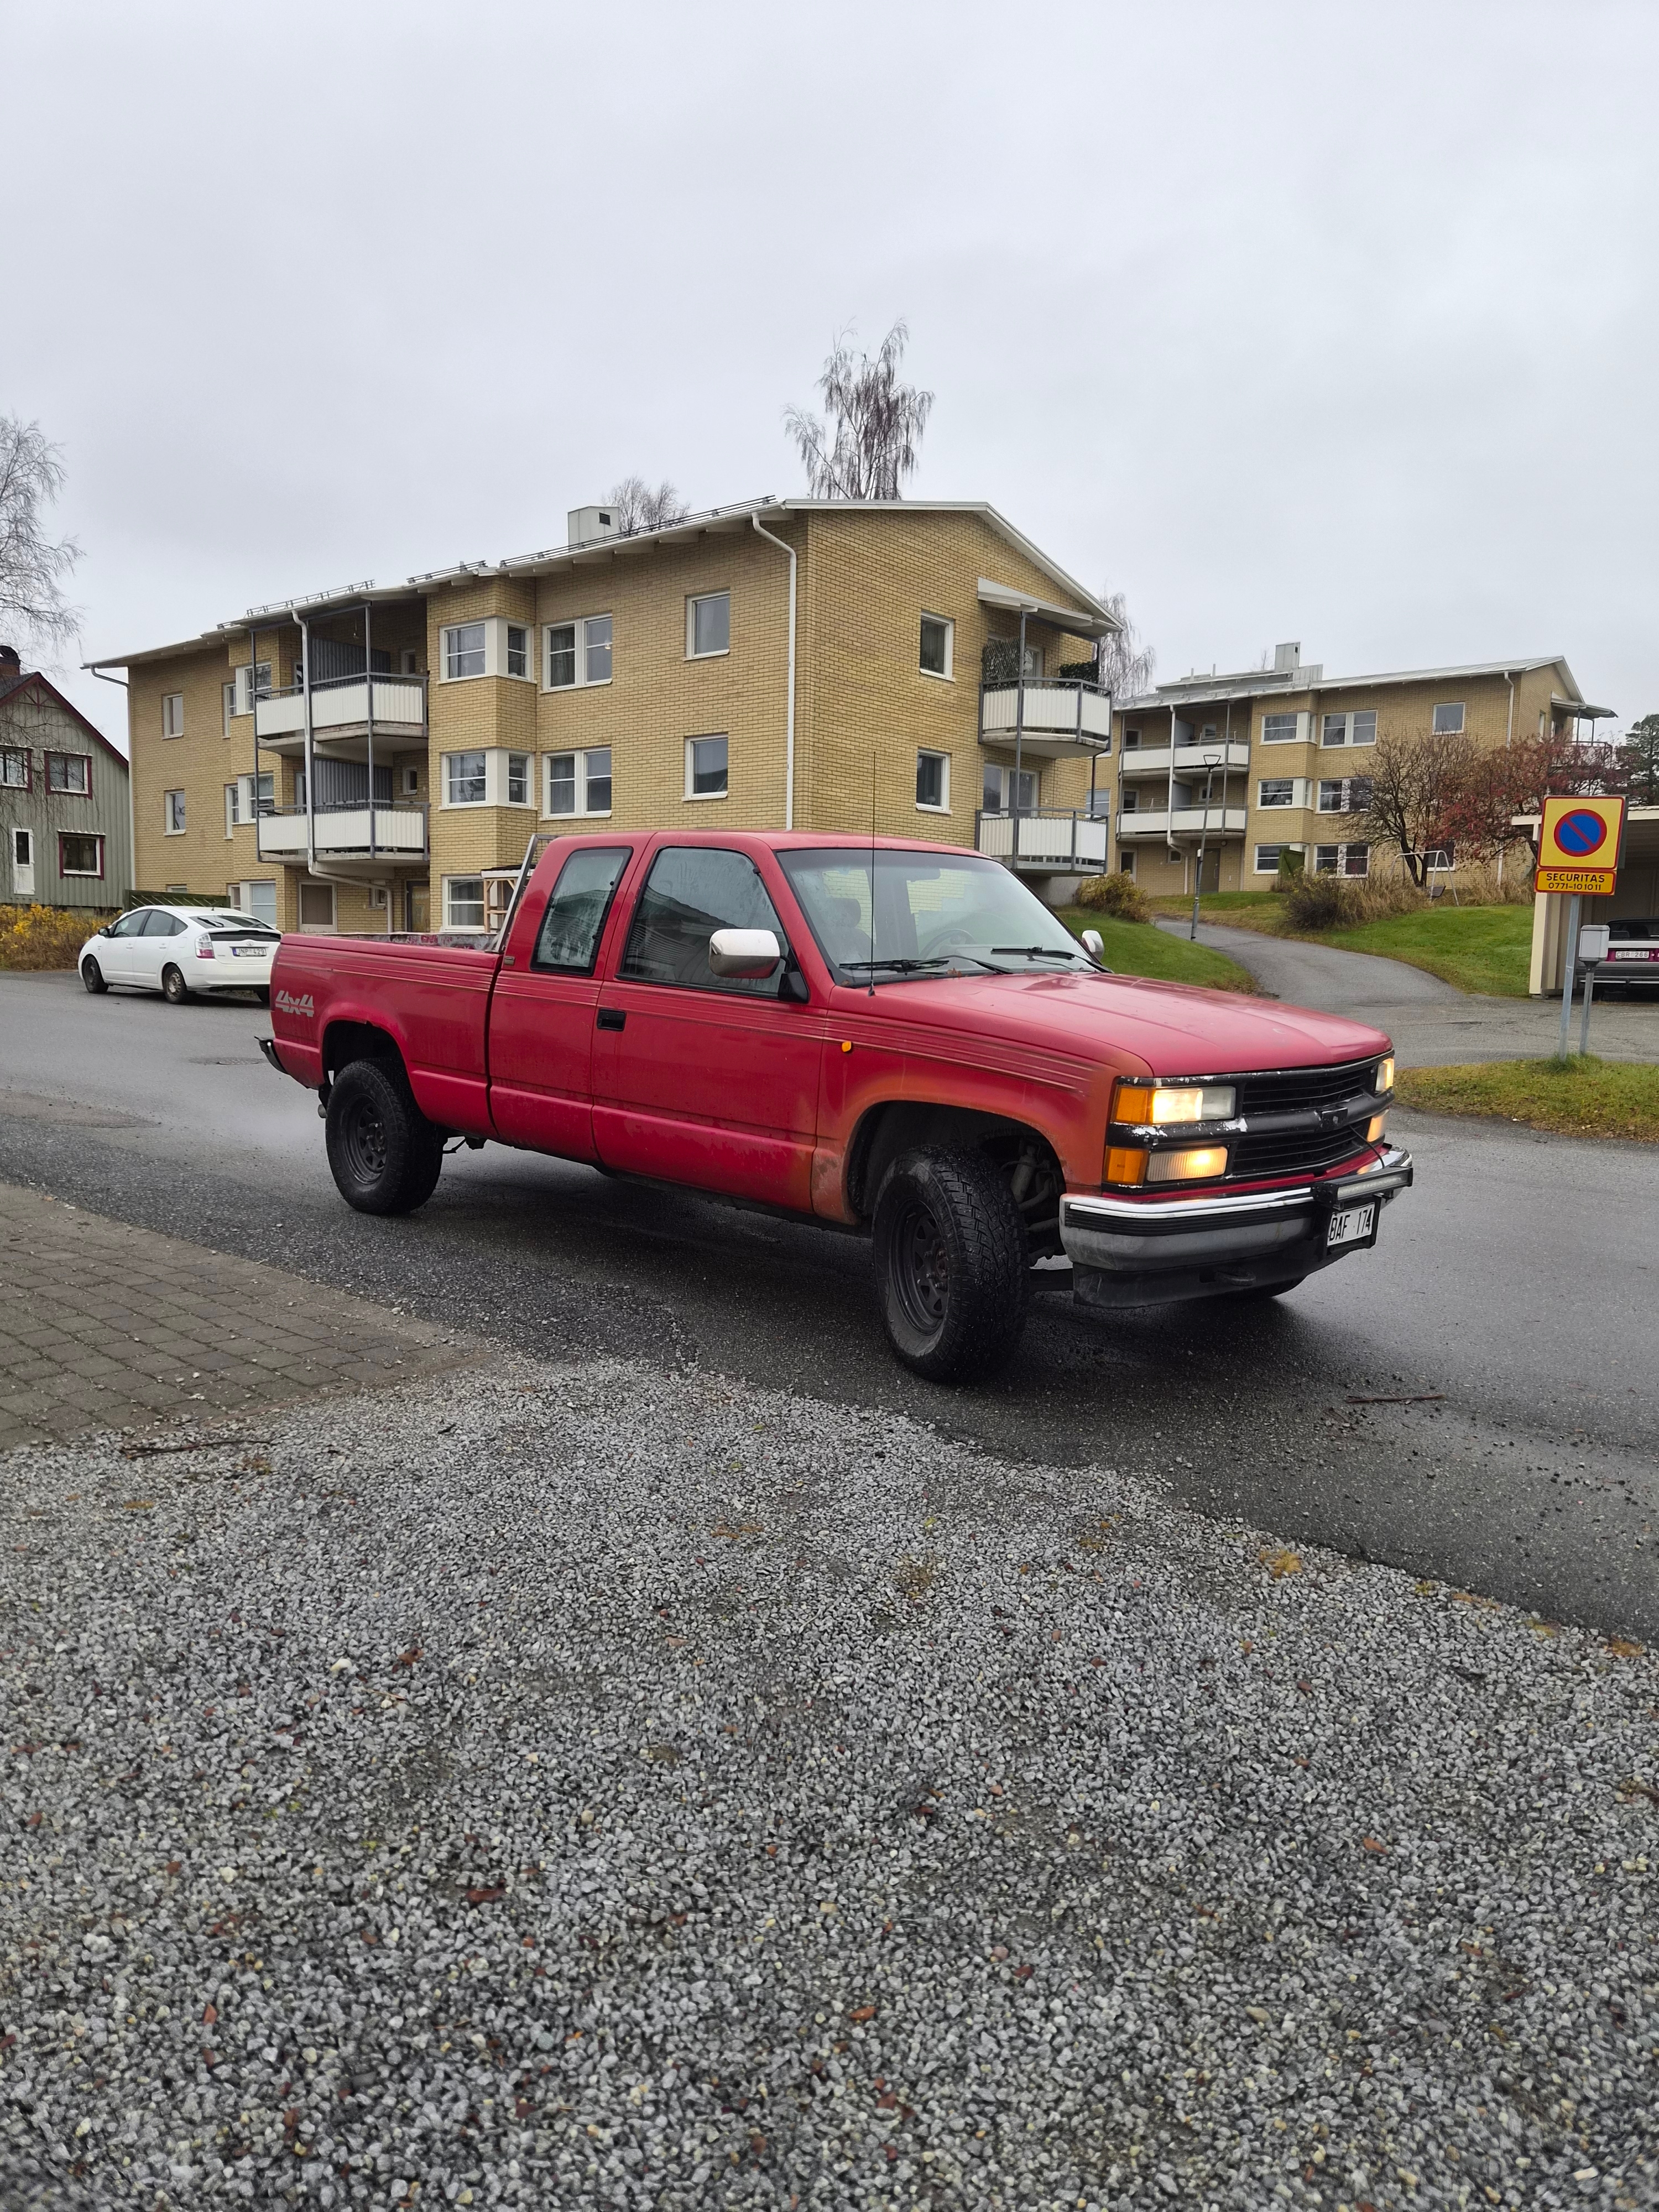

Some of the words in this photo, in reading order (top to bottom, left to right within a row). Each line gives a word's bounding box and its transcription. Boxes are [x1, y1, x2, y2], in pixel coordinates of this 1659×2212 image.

[1546, 873, 1605, 883] SECURITAS
[1329, 1214, 1350, 1241] DAF
[1357, 1208, 1373, 1235] 174
